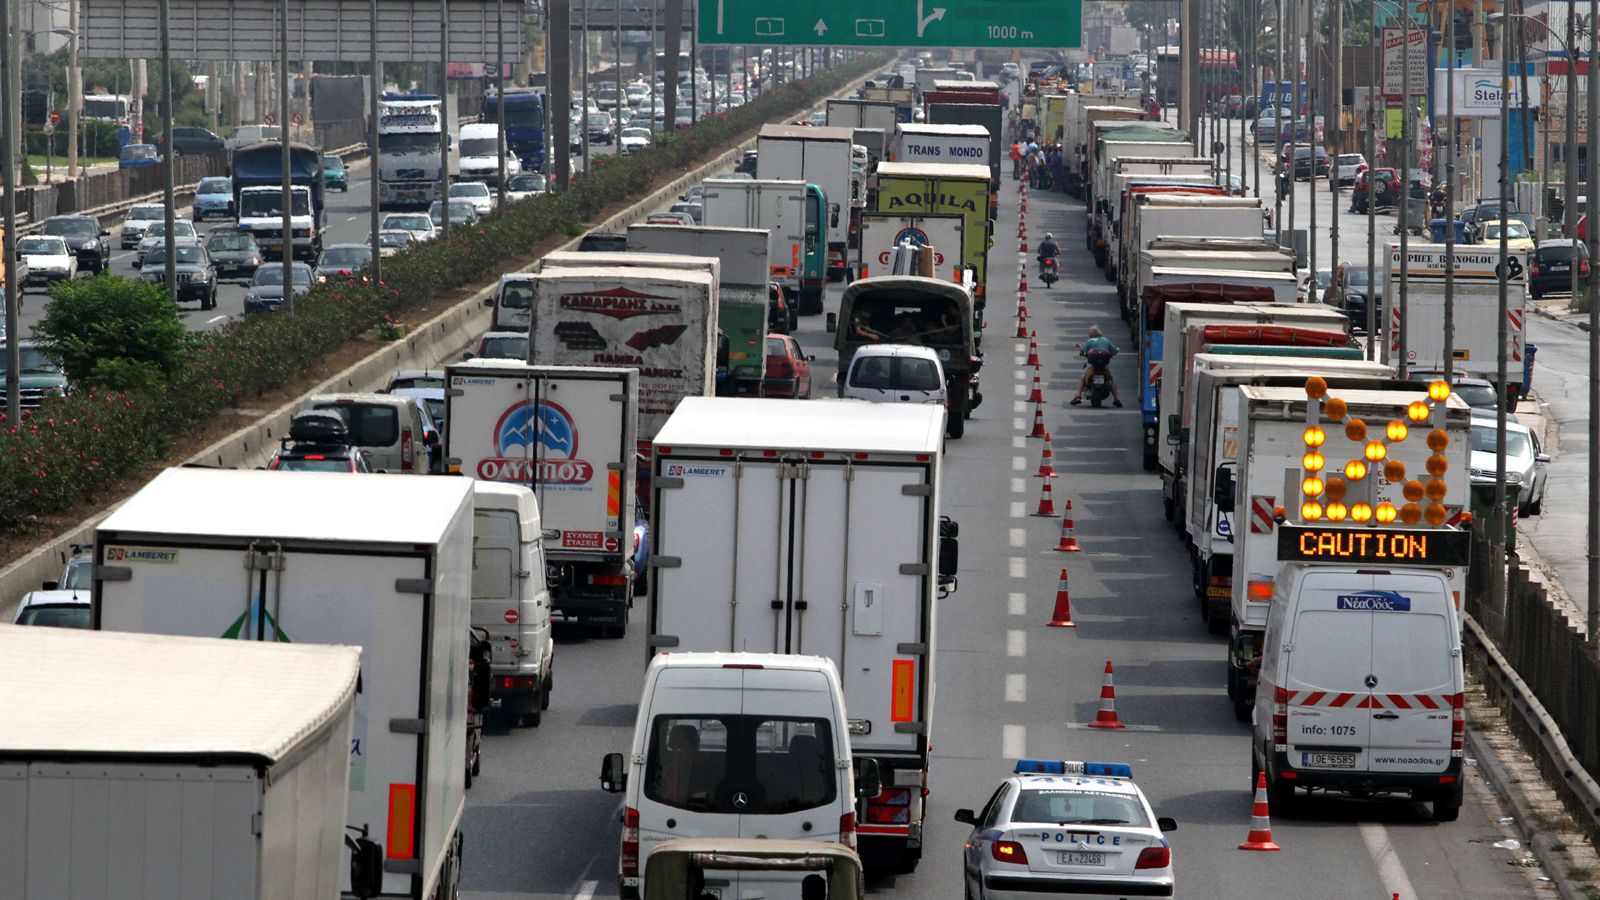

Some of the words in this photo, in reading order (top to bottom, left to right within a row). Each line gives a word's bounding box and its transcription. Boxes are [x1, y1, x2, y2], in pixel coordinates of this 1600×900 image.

[987, 25, 1017, 39] 1000
[1020, 30, 1034, 39] m
[1474, 89, 1520, 101] Stelrt
[907, 144, 941, 157] TRANS
[949, 146, 983, 158] MONDO
[887, 192, 977, 213] AQUILA
[1393, 253, 1433, 263] OPHEE
[480, 461, 589, 481] ΟΛΥΜΠΟΣ
[683, 468, 726, 476] LAMBERET
[1300, 532, 1426, 558] CAUTION
[124, 551, 176, 560] LAMBERET
[1302, 725, 1327, 735] info:
[1331, 726, 1356, 736] 1075
[1375, 756, 1445, 766] www.neaodos.gr
[1065, 764, 1084, 773] POLICE
[1041, 832, 1120, 846] POLICE
